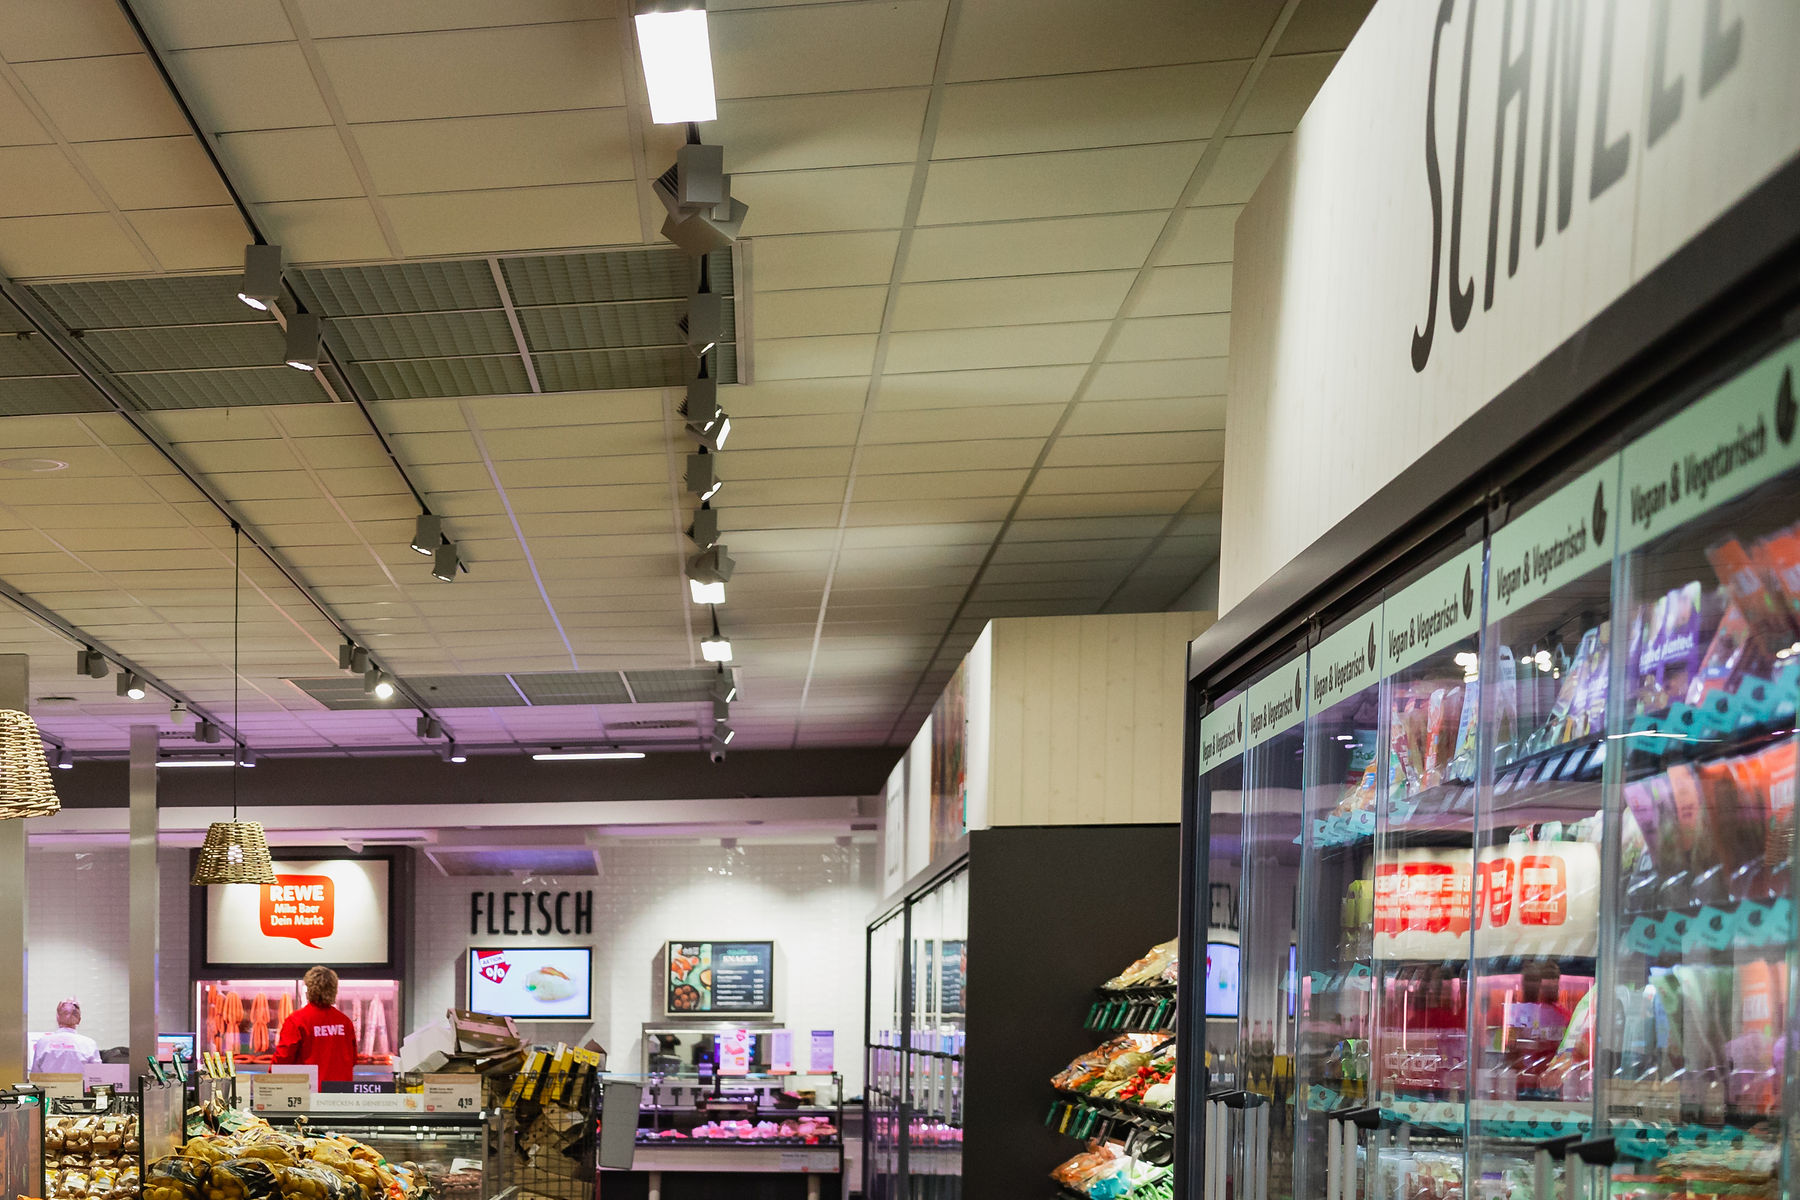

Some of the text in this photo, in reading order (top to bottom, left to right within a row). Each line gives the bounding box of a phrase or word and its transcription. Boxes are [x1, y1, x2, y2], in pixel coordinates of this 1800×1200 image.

[1388, 592, 1458, 664] Vegan & Vegetarisch
[1313, 641, 1366, 705] Vegan & Vegetarisch
[1250, 711, 1263, 739] Vegan
[1268, 689, 1293, 730] Vegetarisch
[270, 885, 324, 901] REWE
[274, 903, 297, 913] Mike
[471, 890, 593, 935] FLEISCH
[271, 915, 324, 926] Dein Markt
[313, 1025, 345, 1037] REWE
[354, 1084, 381, 1093] FISCH
[288, 1097, 302, 1108] 5.79
[458, 1098, 473, 1109] 4.19
